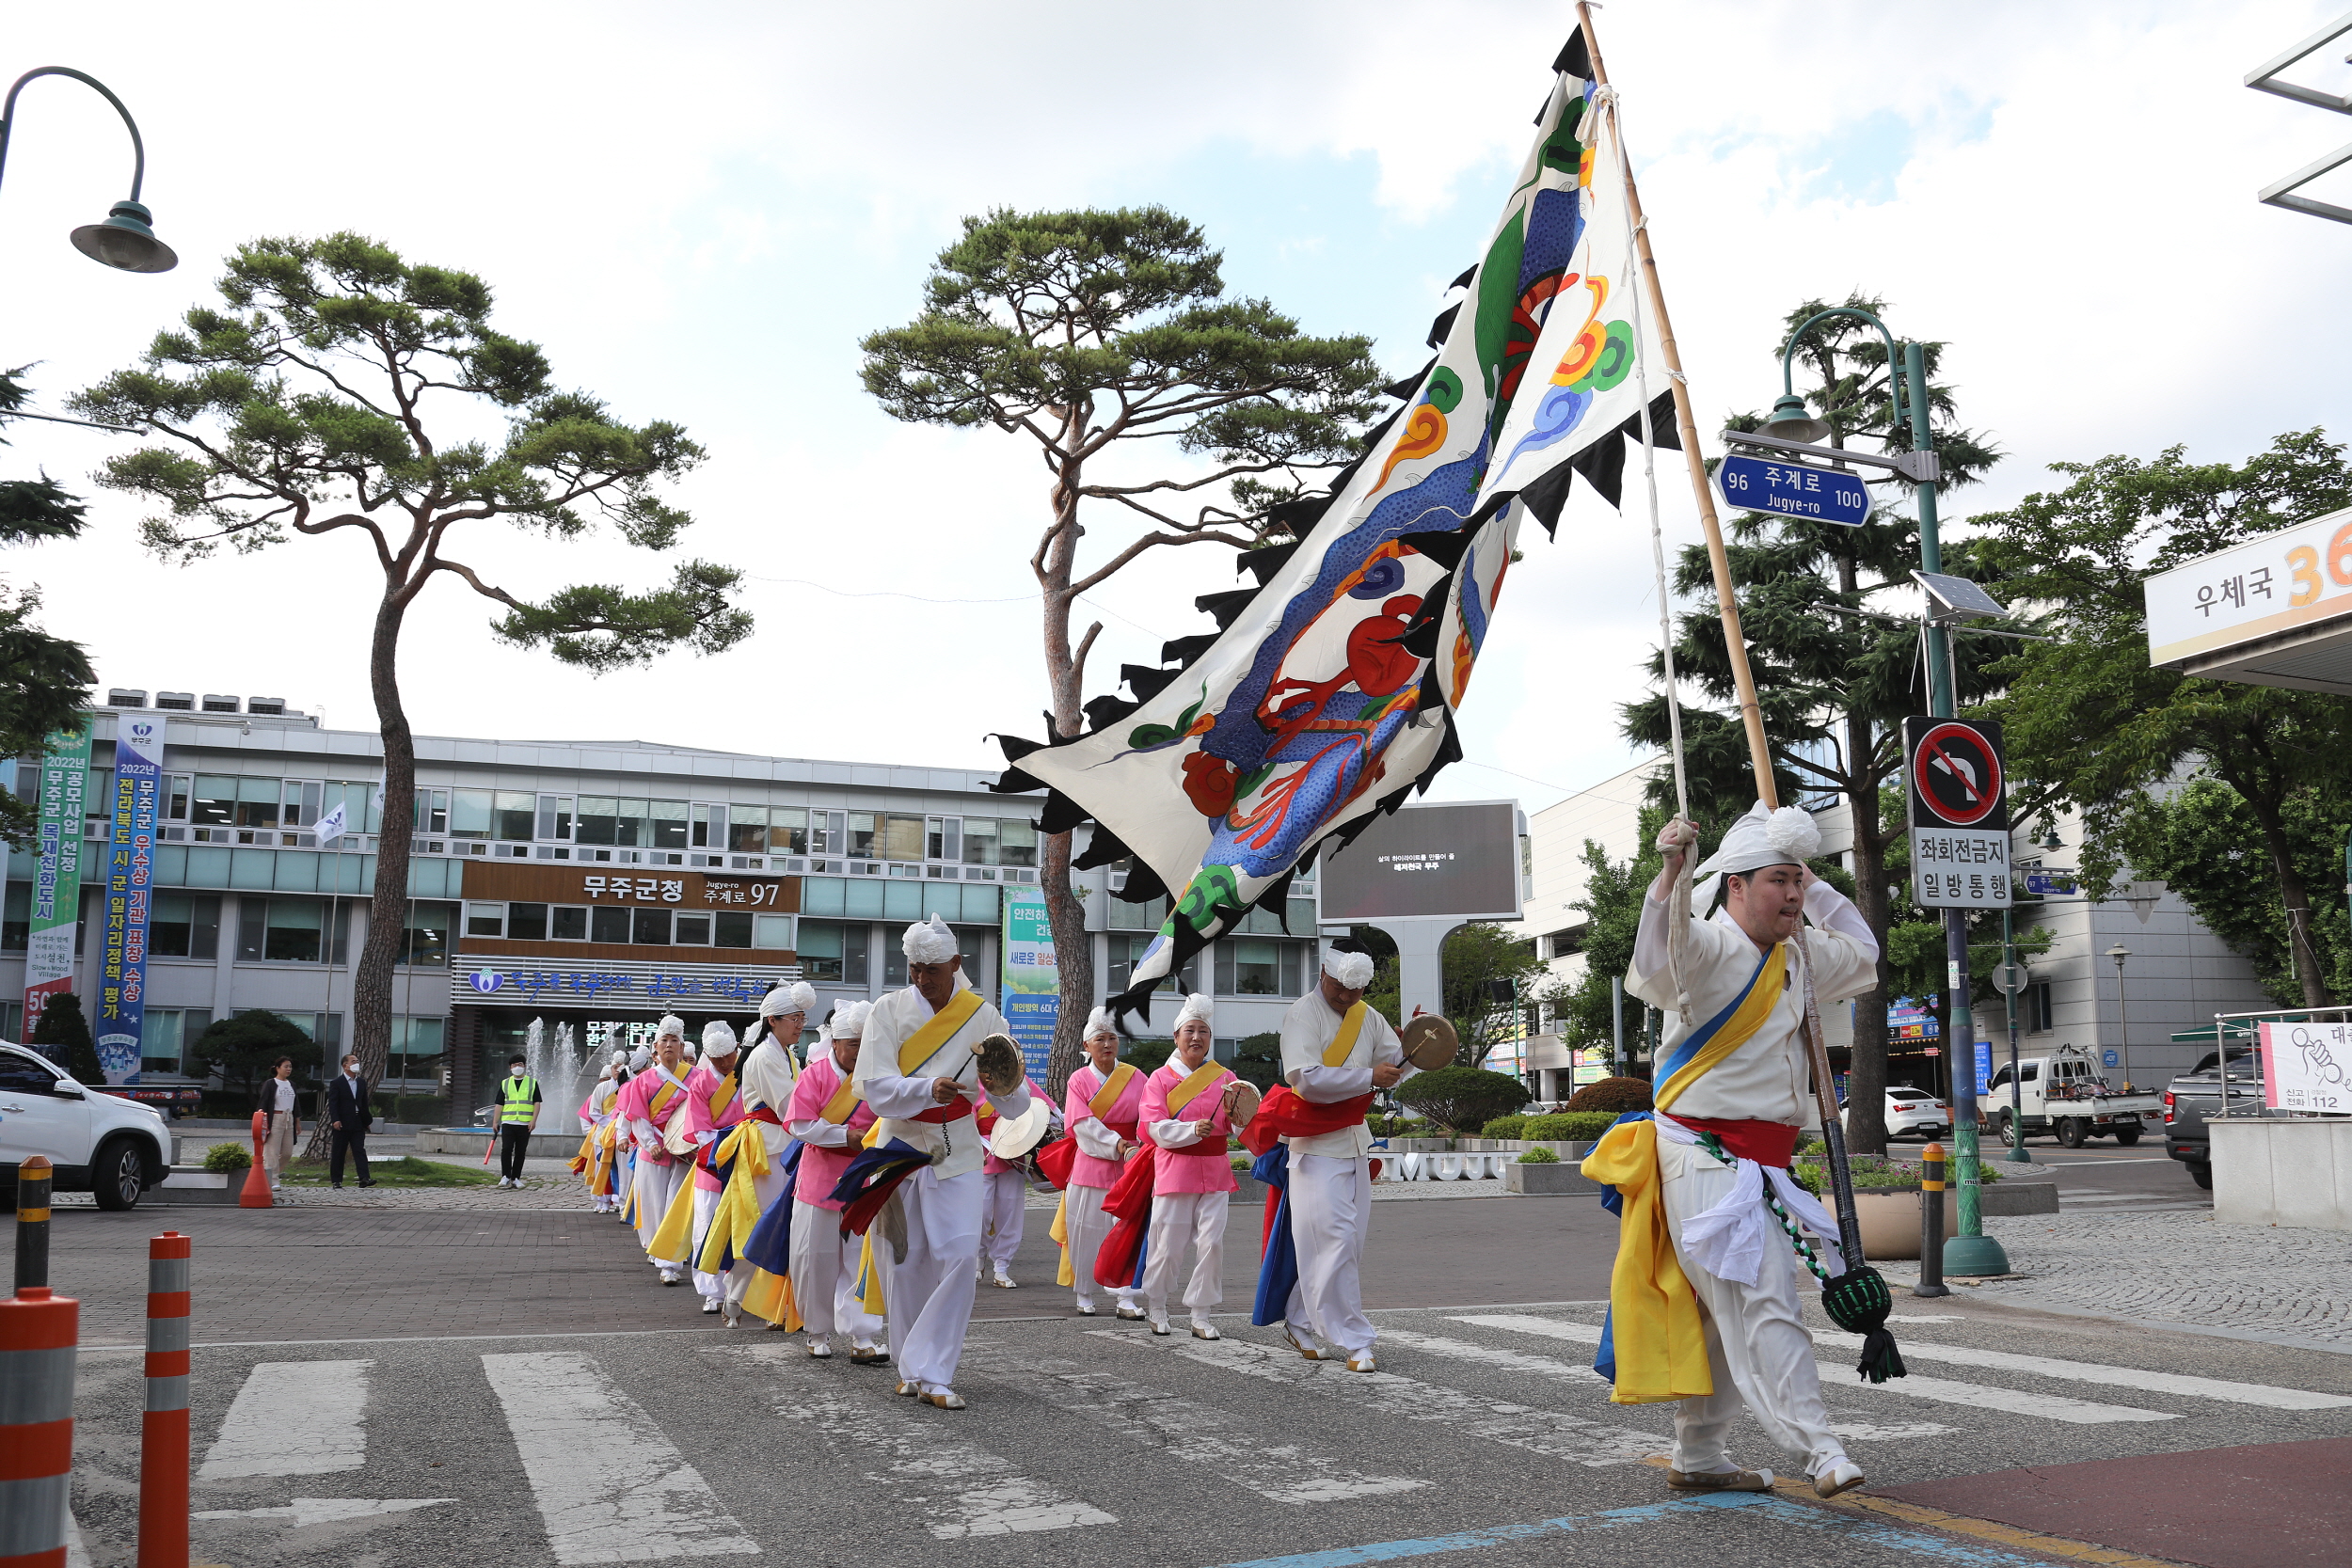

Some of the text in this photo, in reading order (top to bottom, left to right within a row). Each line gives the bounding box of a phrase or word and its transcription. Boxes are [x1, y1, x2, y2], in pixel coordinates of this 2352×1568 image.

[1728, 467, 1861, 509] 96 주계로 100
[1767, 493, 1820, 515] Jugye-ro
[2194, 566, 2273, 618] 우체국
[47, 756, 86, 769] 2022년
[120, 764, 155, 776] 2022년
[59, 770, 84, 873] 공모사업 선정
[114, 778, 135, 845] 전라북도
[35, 769, 64, 920] 무주군 목재친화도시
[1449, 852, 1455, 861] 줄
[1921, 836, 2004, 863] 좌회전금지
[1393, 862, 1439, 871] 레저천국 무주
[123, 780, 155, 1003] 무주군 우수상 기관 표창 수상
[583, 875, 780, 906] 무주군청 97
[704, 890, 747, 904] 주계로
[706, 880, 739, 890] Jugye-ro
[1924, 873, 2007, 900] 일방통행
[104, 896, 127, 981] 일자리정책
[1009, 951, 1035, 965] 새로운
[510, 971, 564, 1004] 무주를
[644, 974, 705, 998] 군민을
[102, 987, 120, 1021] 평가
[1011, 1003, 1039, 1013] 개인방역
[1040, 1004, 1052, 1013] 6대
[2286, 1088, 2305, 1097] 신고
[2287, 1097, 2338, 1108] 전화 112
